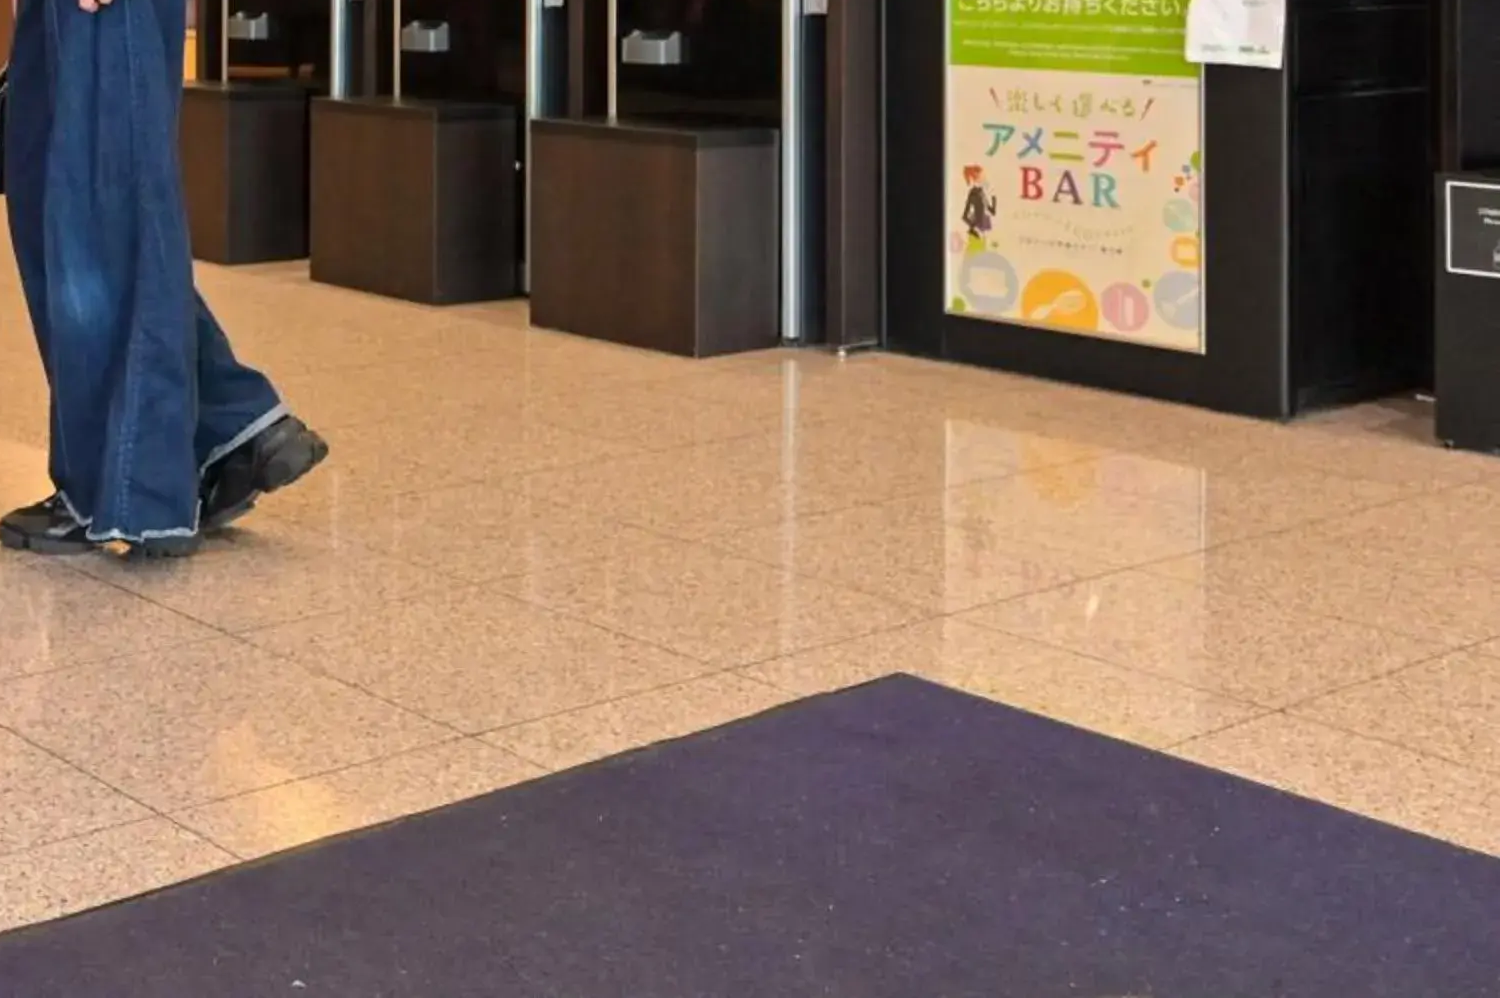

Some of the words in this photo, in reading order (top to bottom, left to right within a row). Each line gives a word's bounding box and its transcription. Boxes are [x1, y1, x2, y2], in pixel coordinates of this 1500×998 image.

[982, 123, 1158, 173] アメニティ
[1019, 166, 1120, 209] BAR
